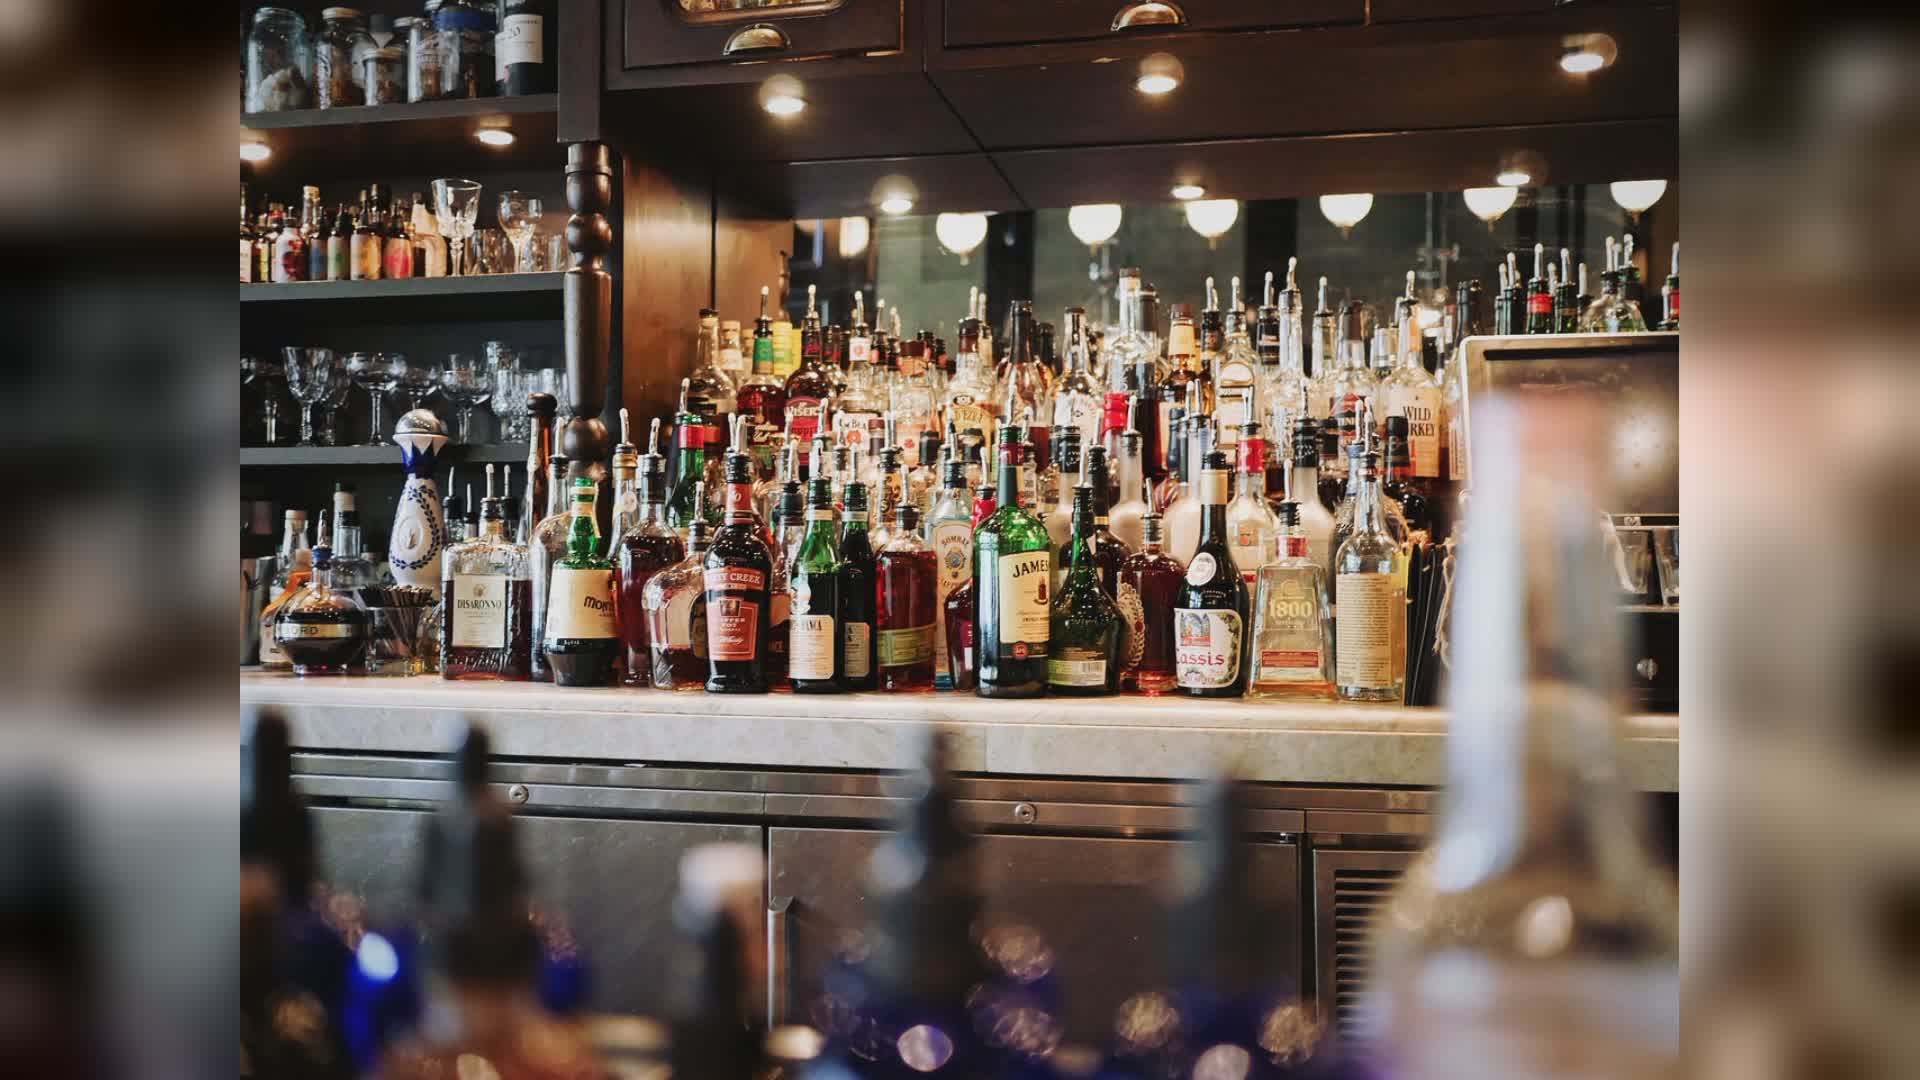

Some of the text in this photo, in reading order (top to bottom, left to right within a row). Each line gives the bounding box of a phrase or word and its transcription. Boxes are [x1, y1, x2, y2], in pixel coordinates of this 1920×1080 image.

[1402, 406, 1432, 421] WILD
[1409, 423, 1435, 437] RKEY
[730, 573, 760, 584] CREEK
[457, 599, 502, 609] DISARONNO
[1268, 601, 1312, 618] 1800
[1176, 650, 1225, 666] assis
